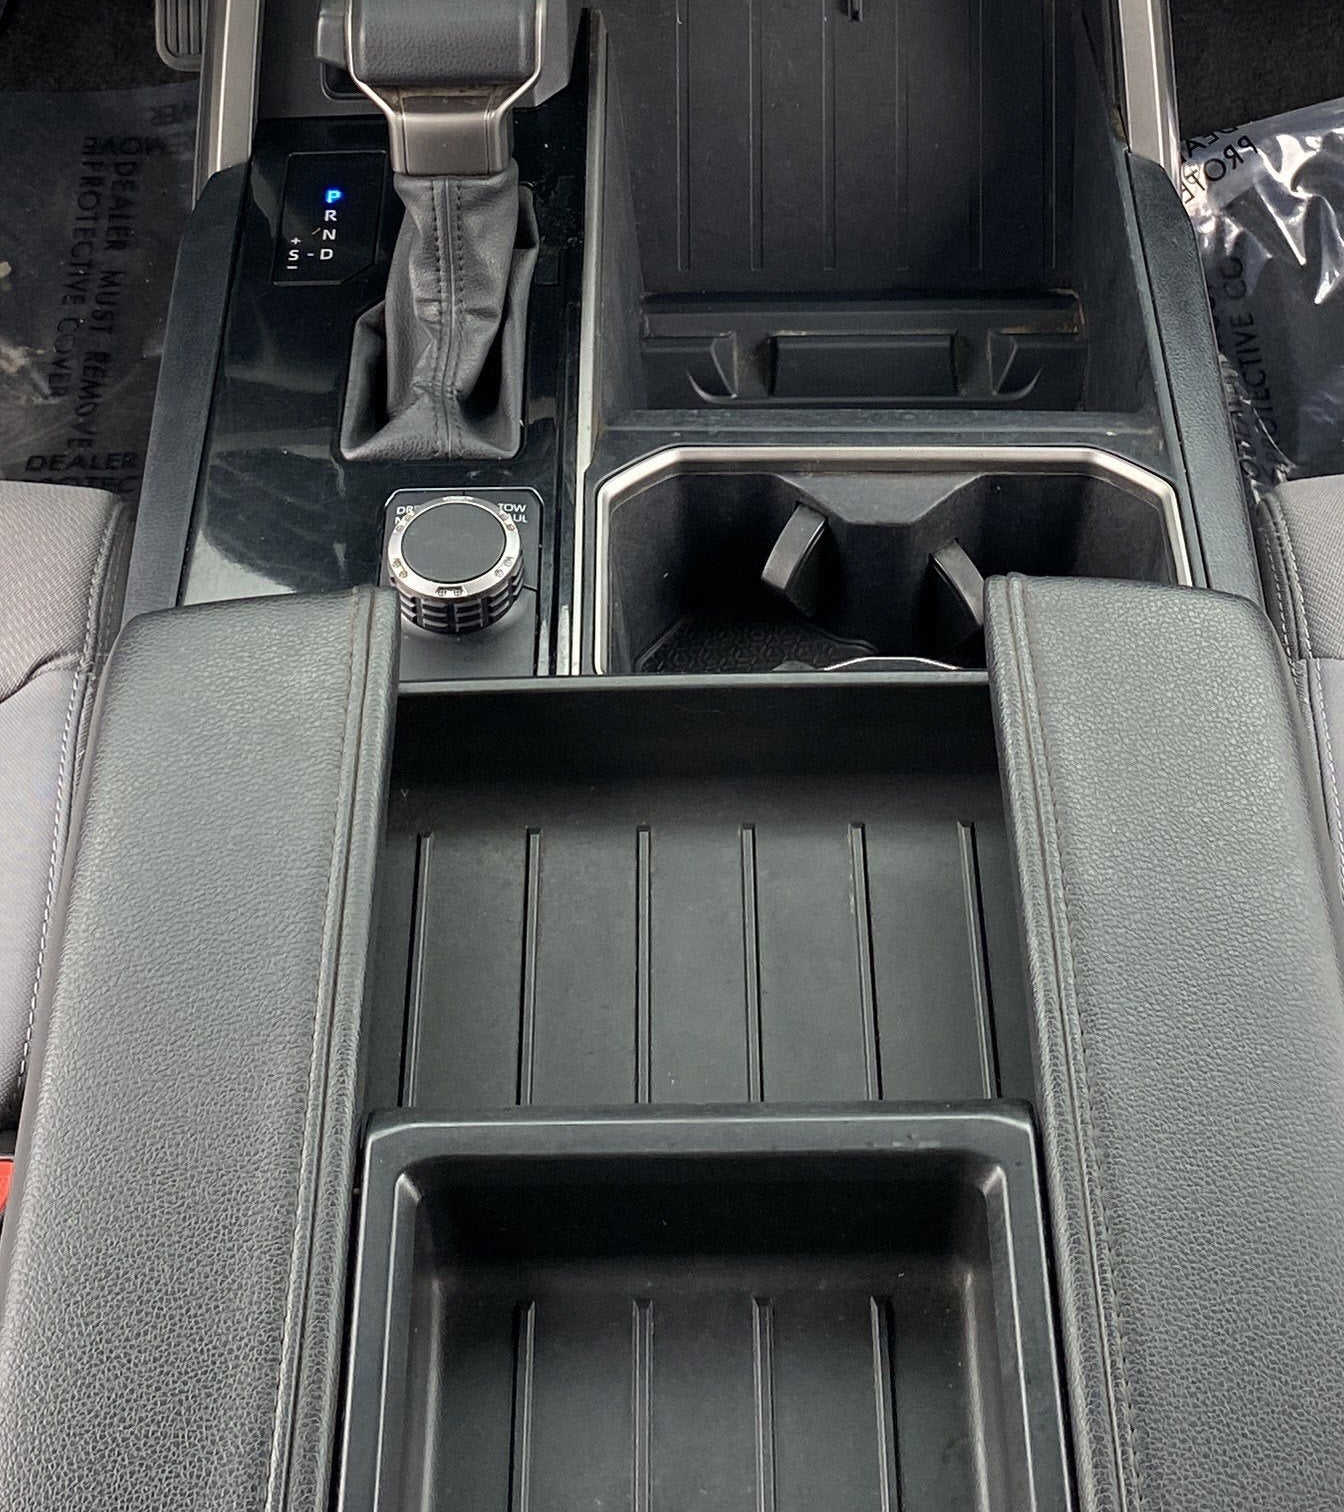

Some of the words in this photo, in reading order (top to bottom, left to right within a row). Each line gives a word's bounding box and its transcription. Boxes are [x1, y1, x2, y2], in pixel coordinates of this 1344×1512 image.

[326, 189, 342, 203] P
[324, 209, 337, 221] R
[322, 229, 336, 240] N
[288, 249, 299, 261] S
[320, 248, 334, 260] D
[497, 502, 527, 513] TOW
